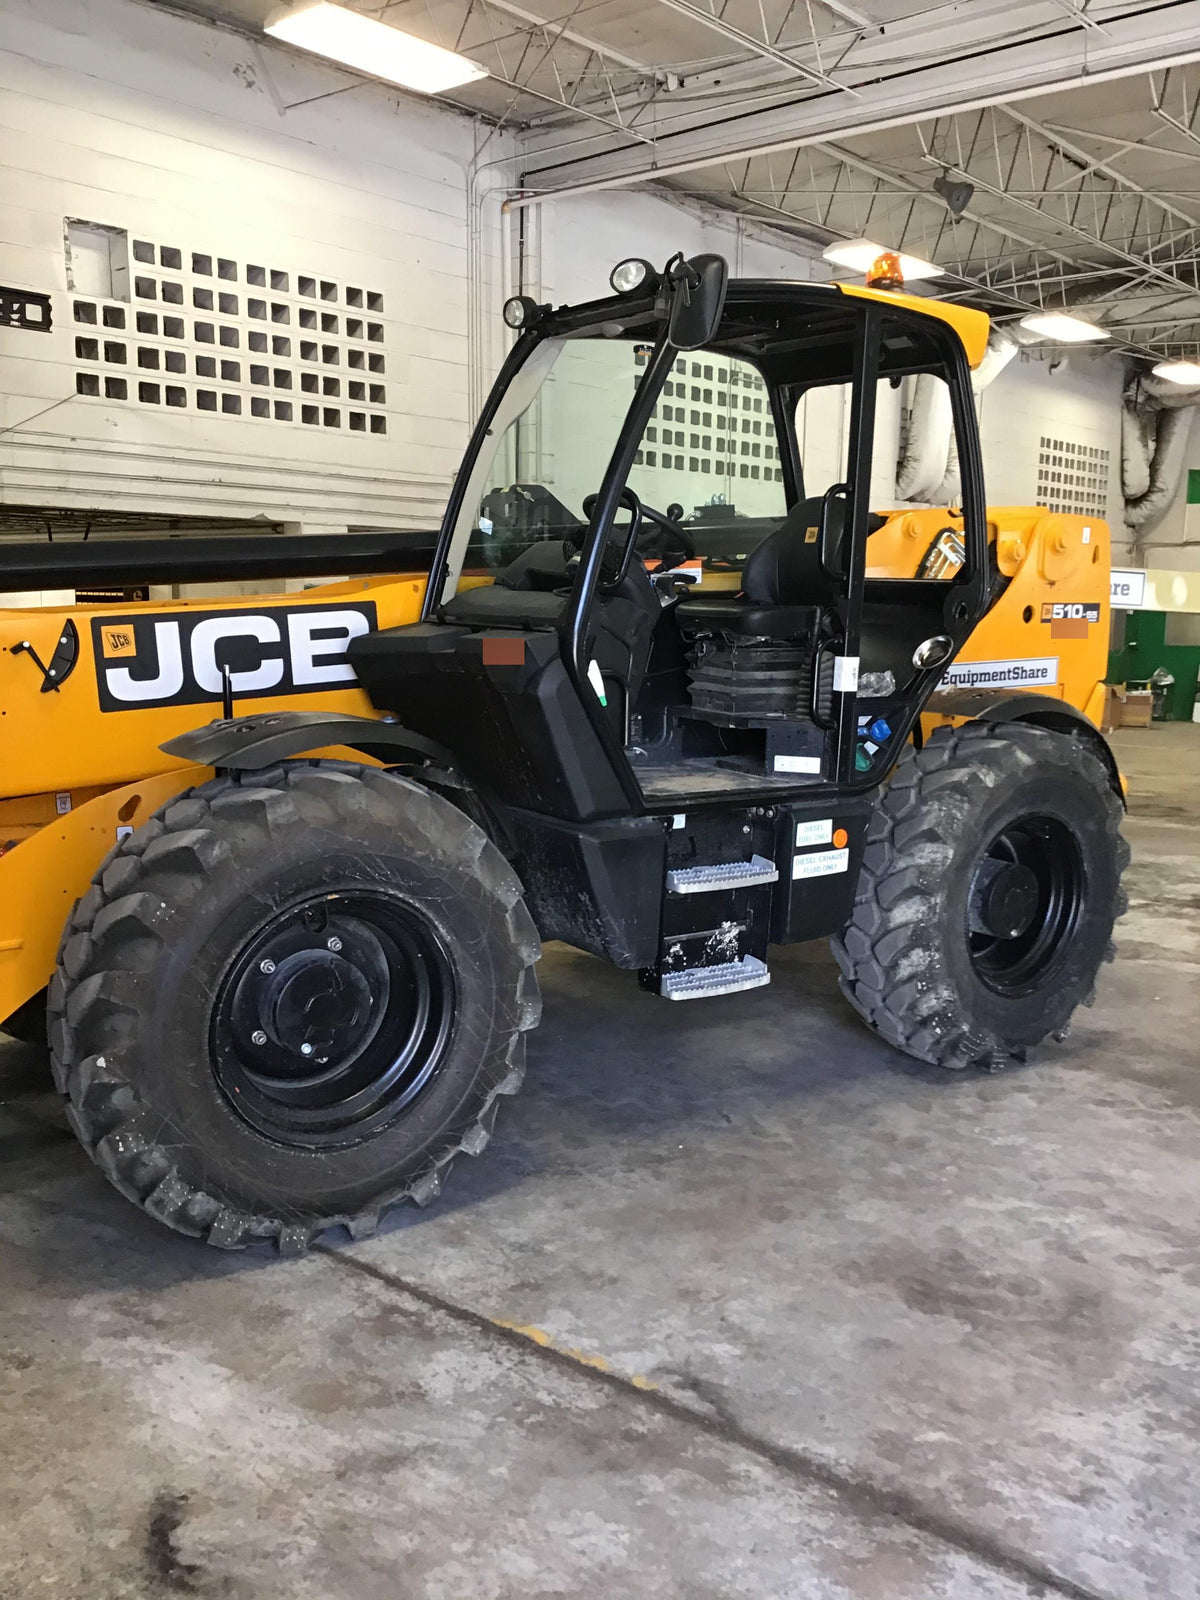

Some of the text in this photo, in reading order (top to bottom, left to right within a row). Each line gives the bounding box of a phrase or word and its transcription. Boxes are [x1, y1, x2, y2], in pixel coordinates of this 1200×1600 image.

[1110, 583, 1130, 596] re
[110, 634, 130, 649] JCB
[105, 610, 370, 702] JCB
[941, 666, 1048, 686] EquipmentShare
[804, 824, 824, 832] DIESEL
[795, 852, 847, 866] DIESEL EXHAUST
[803, 864, 838, 874] FLUID ONLY
